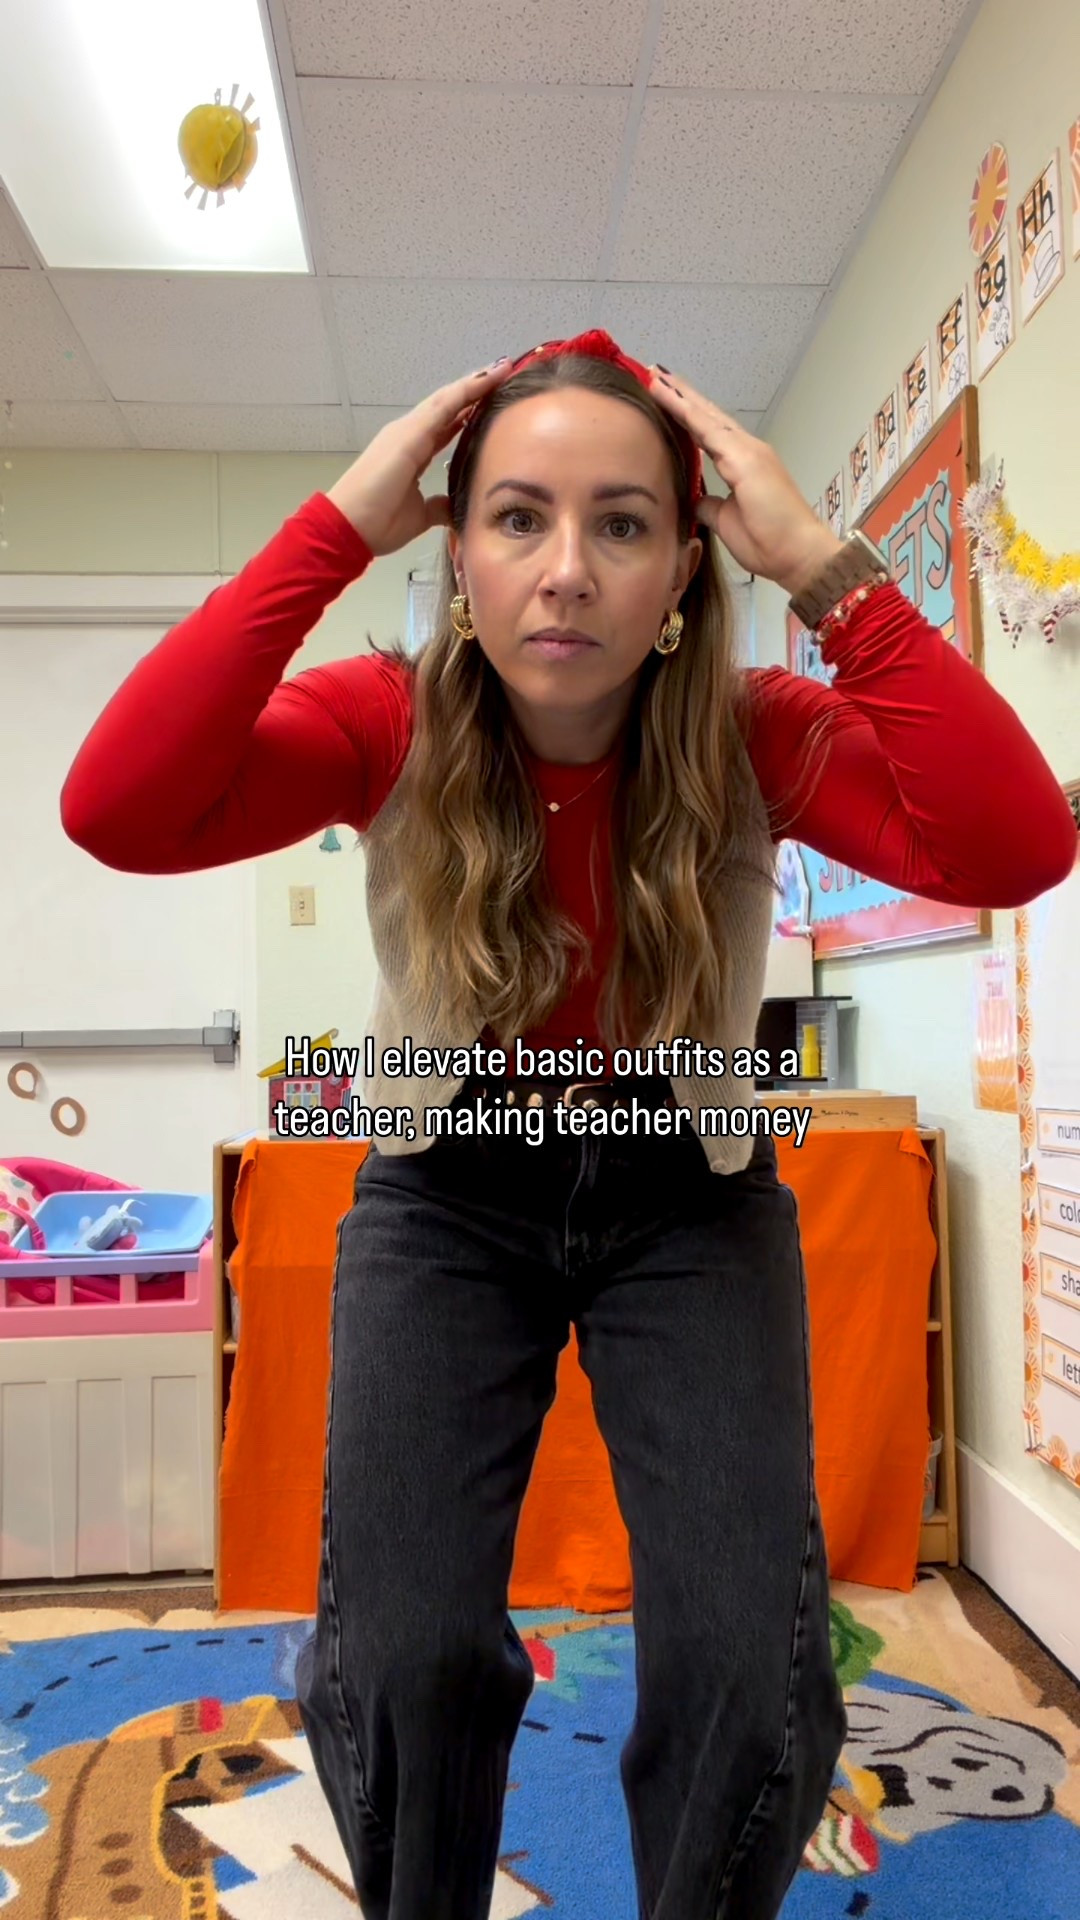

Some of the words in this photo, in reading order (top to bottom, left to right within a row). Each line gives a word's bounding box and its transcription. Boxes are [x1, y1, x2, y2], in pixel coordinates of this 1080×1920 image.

[1021, 178, 1055, 253] Hh
[978, 254, 1007, 311] Gg
[940, 297, 962, 366] Ff
[907, 361, 927, 410] Ee
[876, 394, 896, 451] Dd
[853, 446, 868, 482] Cc
[828, 479, 841, 520] Bb
